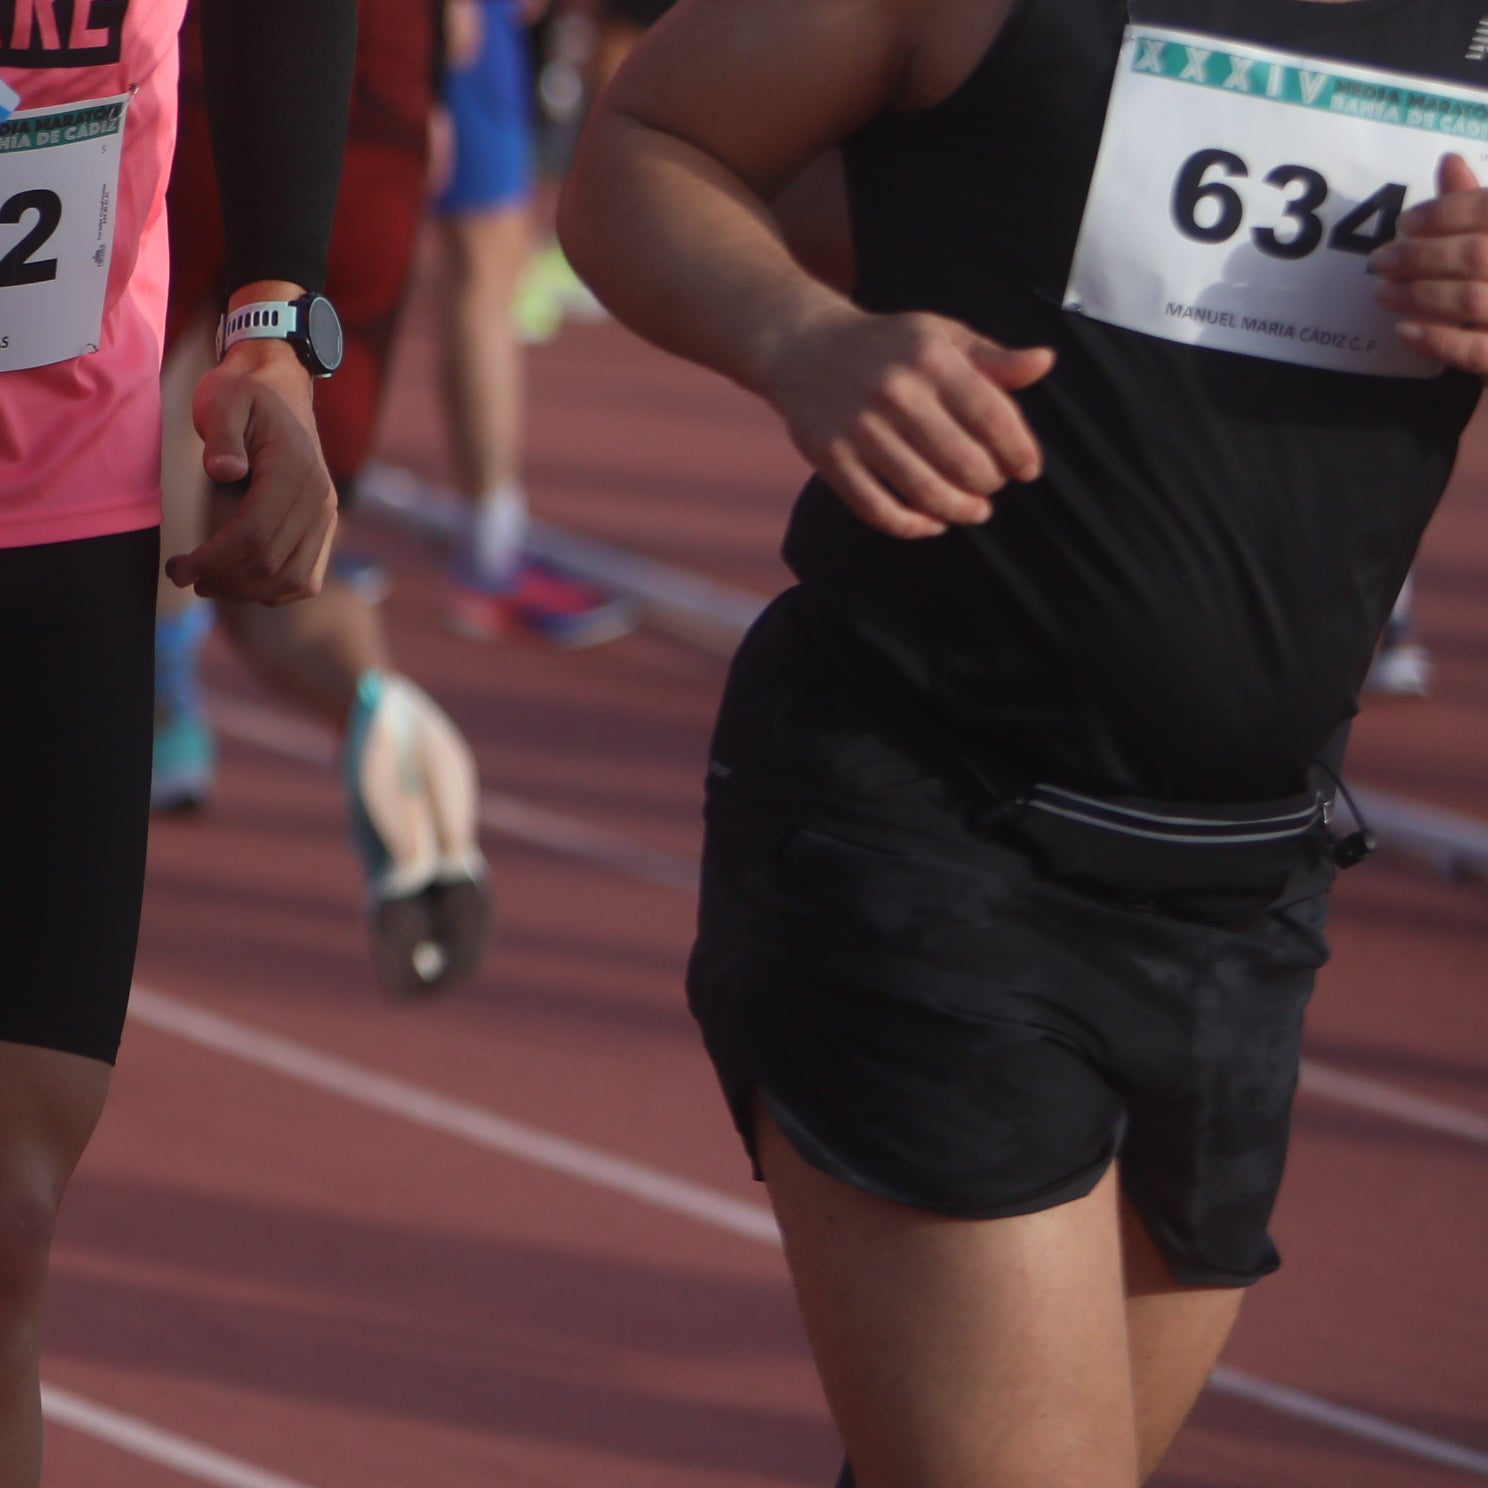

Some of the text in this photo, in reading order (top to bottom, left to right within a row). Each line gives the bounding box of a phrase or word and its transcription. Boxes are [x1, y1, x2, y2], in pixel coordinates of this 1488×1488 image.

[1333, 80, 1400, 104] MEDIA
[1406, 109, 1435, 128] DE
[36, 132, 60, 146] DE
[64, 120, 116, 140] CÁDIZ
[1169, 148, 1408, 275] 634
[1165, 302, 1236, 328] MANUEL
[1240, 317, 1294, 339] MARIA
